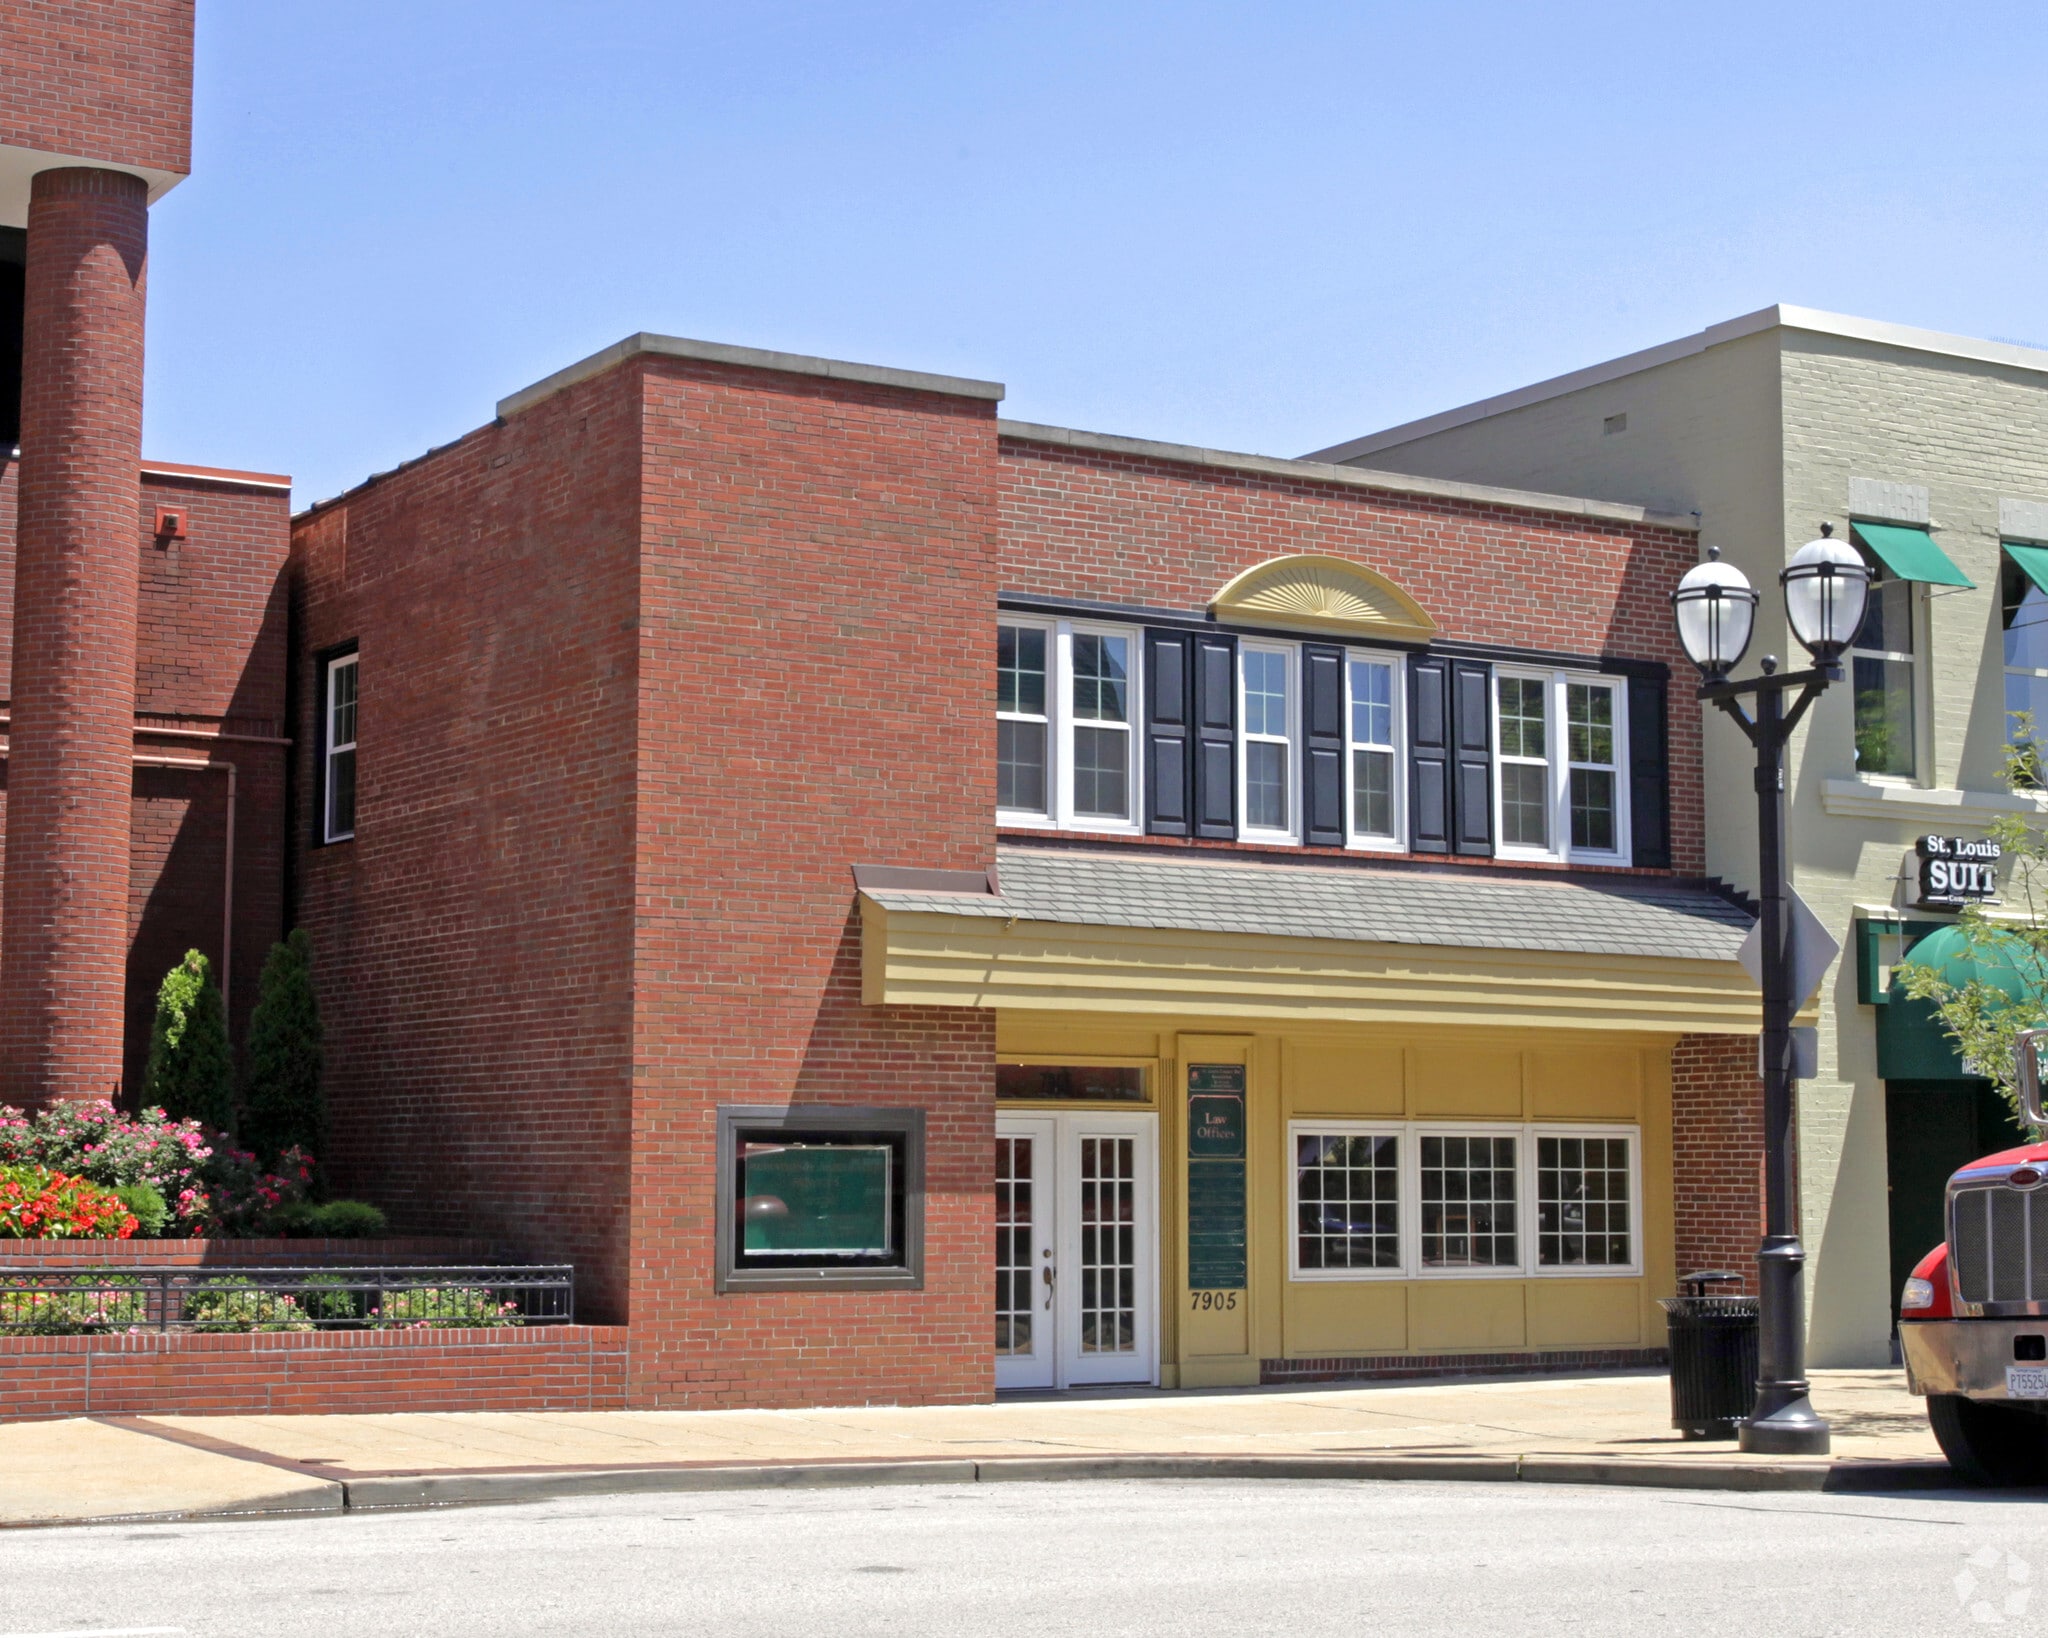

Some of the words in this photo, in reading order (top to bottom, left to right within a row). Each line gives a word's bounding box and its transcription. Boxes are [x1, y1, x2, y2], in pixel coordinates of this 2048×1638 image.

[1927, 835, 1950, 853] St.
[1956, 838, 2000, 857] Louis
[1930, 860, 1997, 891] SUIT
[1205, 1112, 1228, 1125] Law
[1191, 1291, 1237, 1311] 7905
